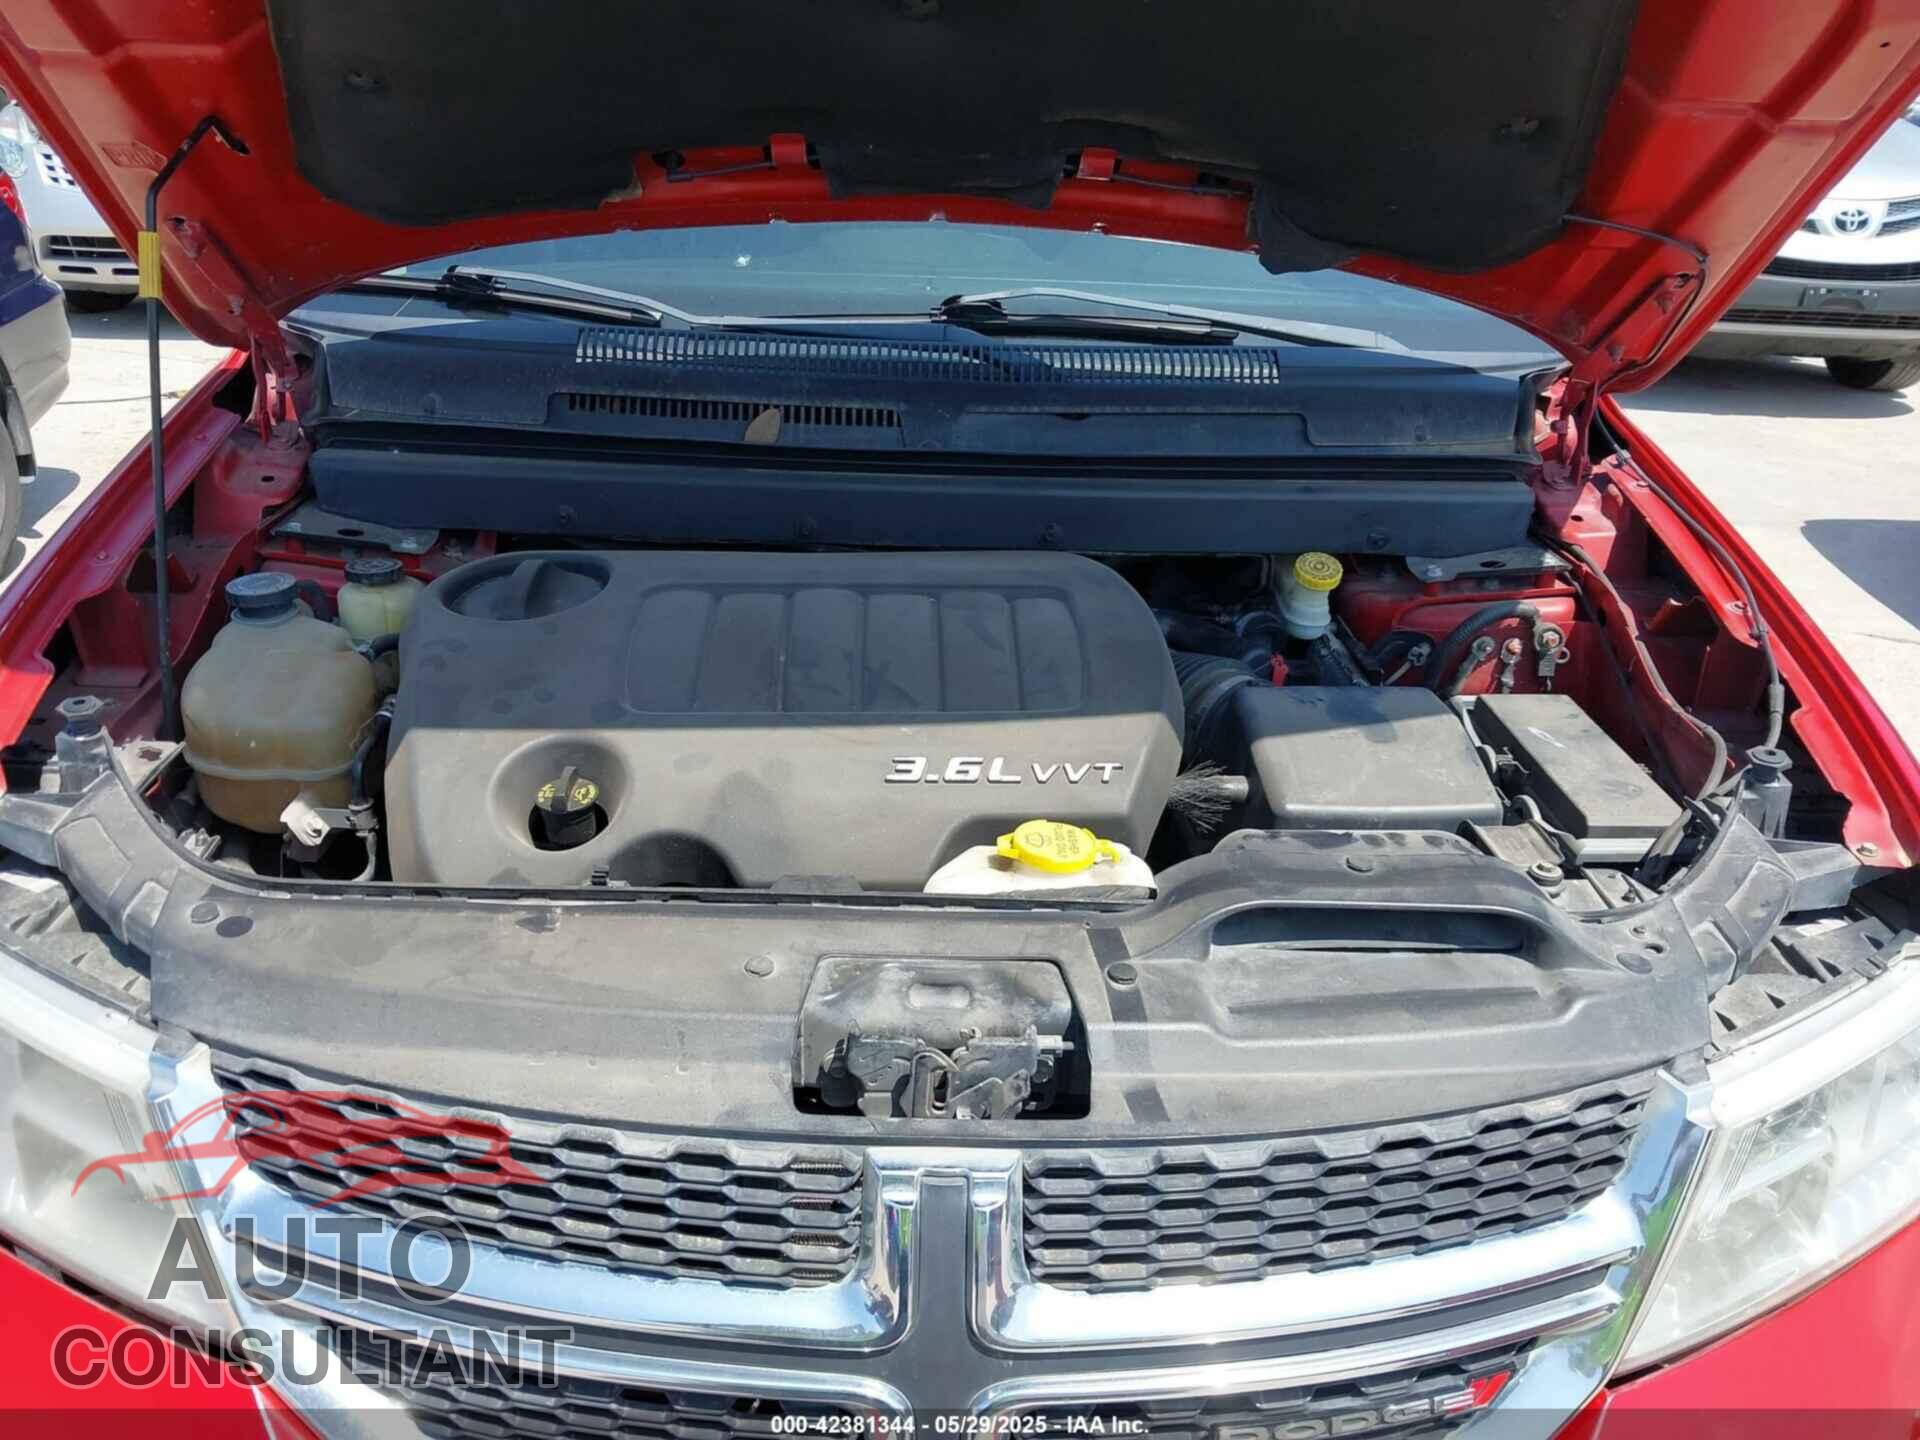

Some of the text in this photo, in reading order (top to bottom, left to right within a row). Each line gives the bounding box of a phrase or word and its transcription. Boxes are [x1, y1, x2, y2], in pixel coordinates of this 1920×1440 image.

[883, 756, 1123, 784] 3.6L VVT
[1215, 1388, 1476, 1440] DODGE
